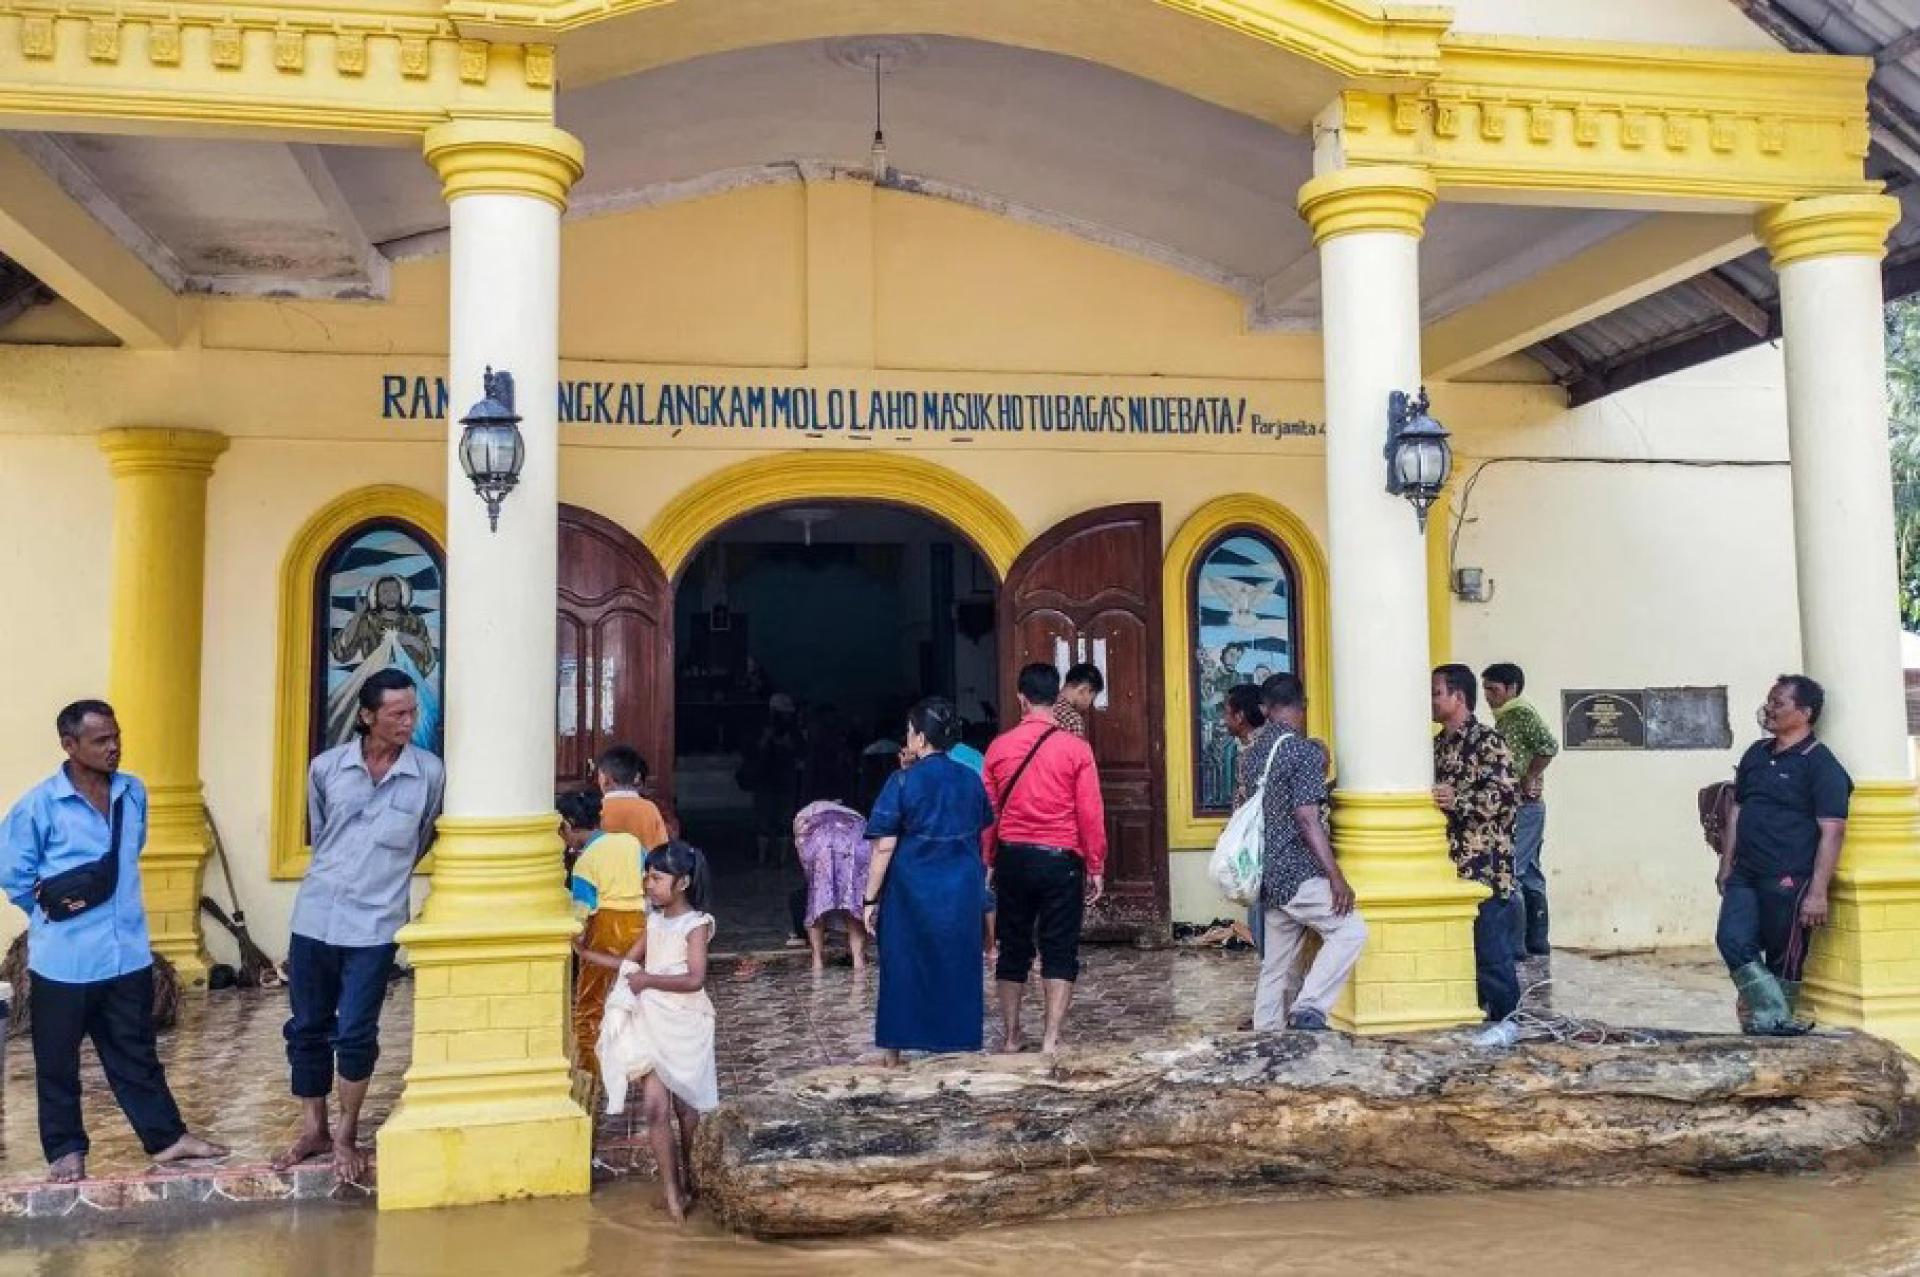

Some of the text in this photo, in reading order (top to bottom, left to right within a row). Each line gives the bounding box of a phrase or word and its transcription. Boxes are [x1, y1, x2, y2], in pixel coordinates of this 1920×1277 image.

[771, 386, 844, 429] MOLO
[849, 390, 917, 430] LAHO
[1150, 397, 1246, 433] DEBATA!
